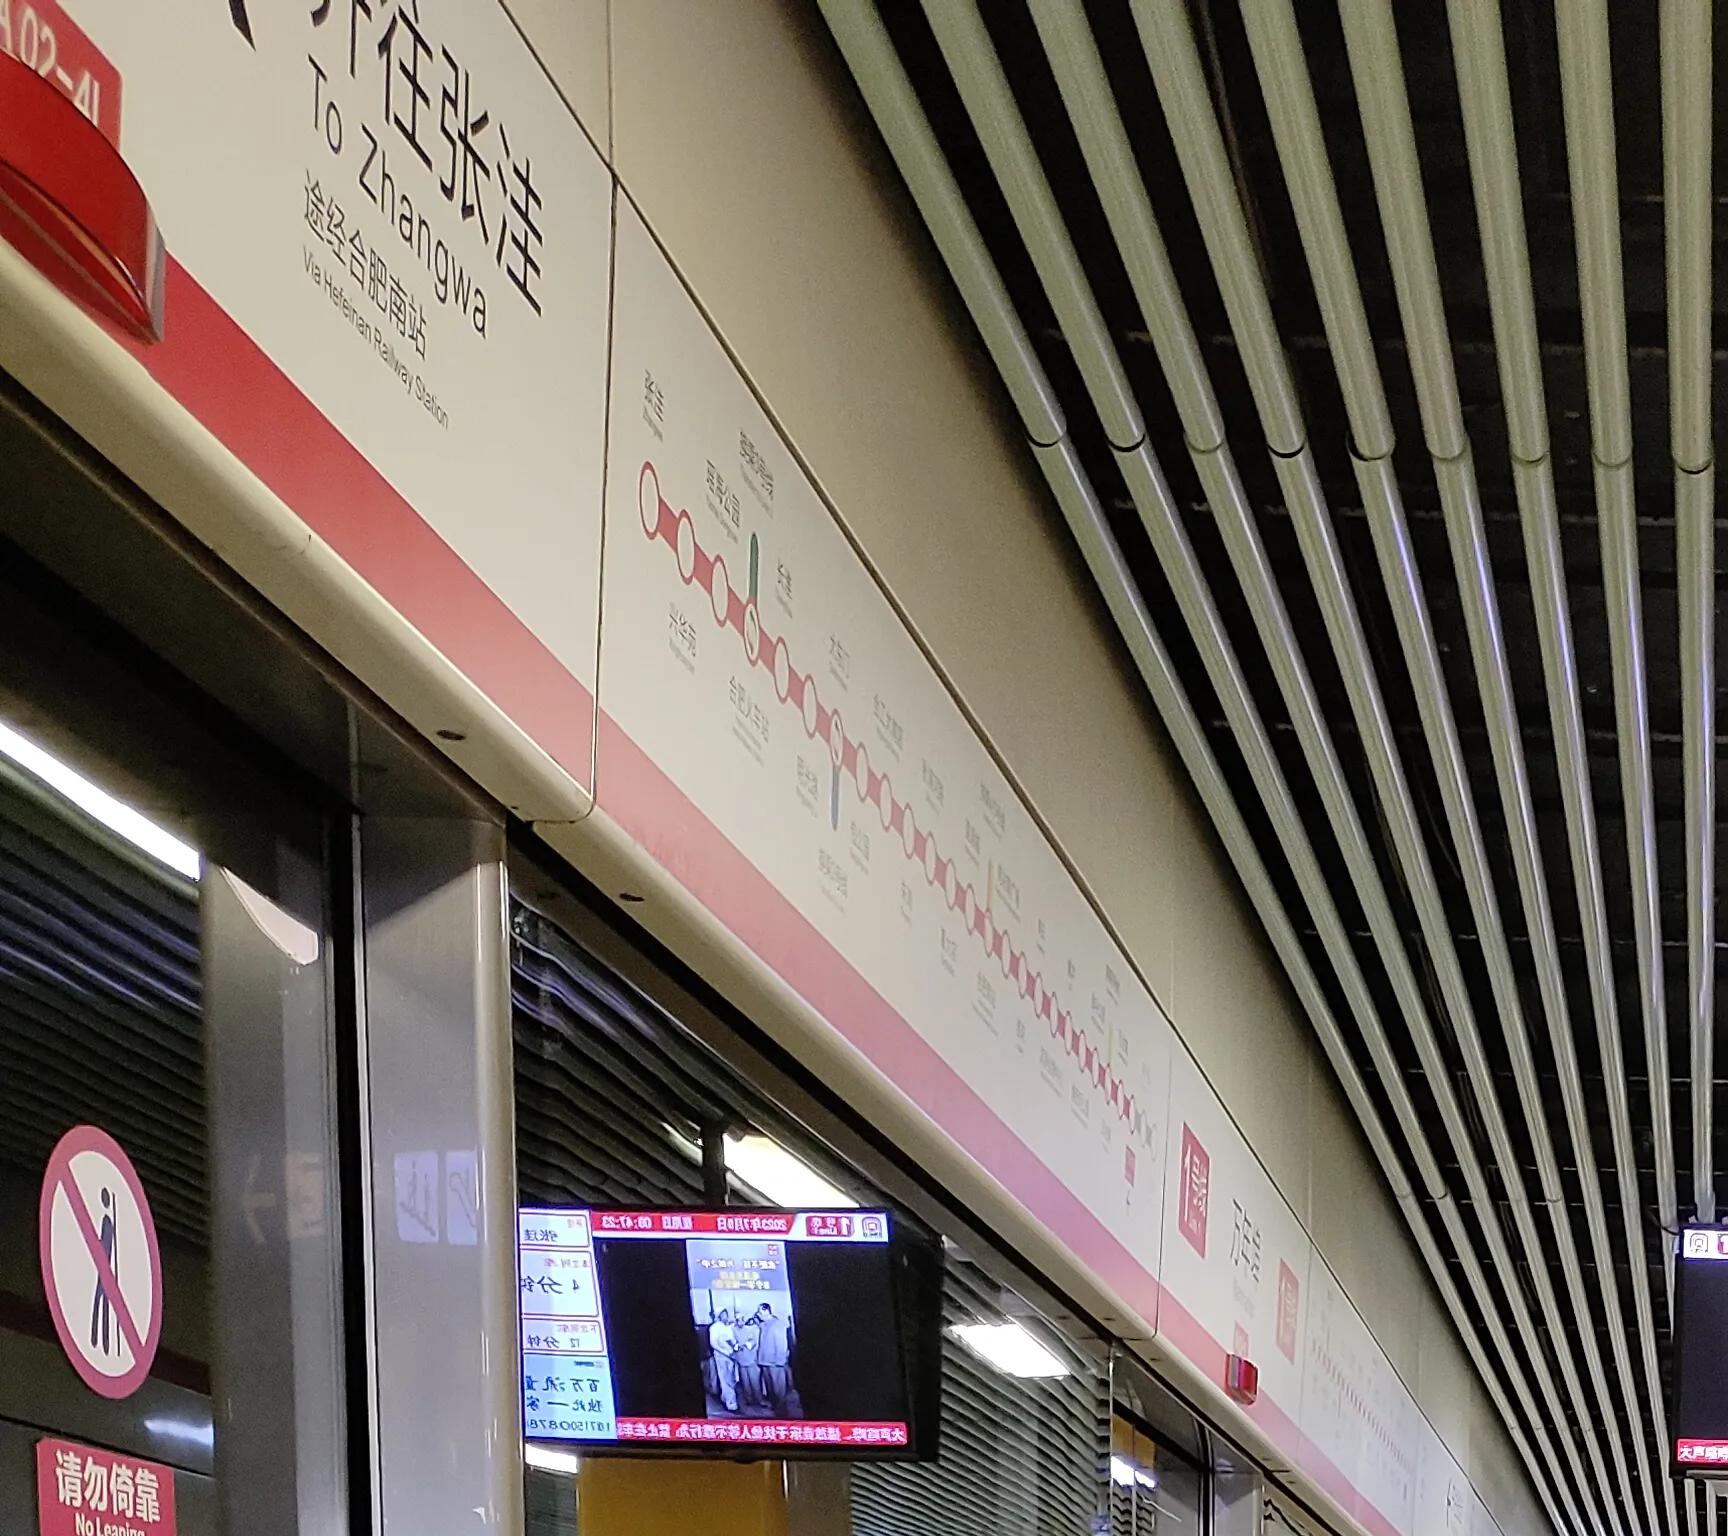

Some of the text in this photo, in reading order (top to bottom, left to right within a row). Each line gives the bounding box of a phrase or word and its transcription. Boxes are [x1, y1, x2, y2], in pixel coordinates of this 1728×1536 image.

[304, 169, 427, 361] 途经合肥南站
[308, 53, 487, 339] To Zhangwa
[303, 245, 449, 430] Via Hefeinan Railway Station
[56, 1448, 160, 1523] 请勿倚靠
